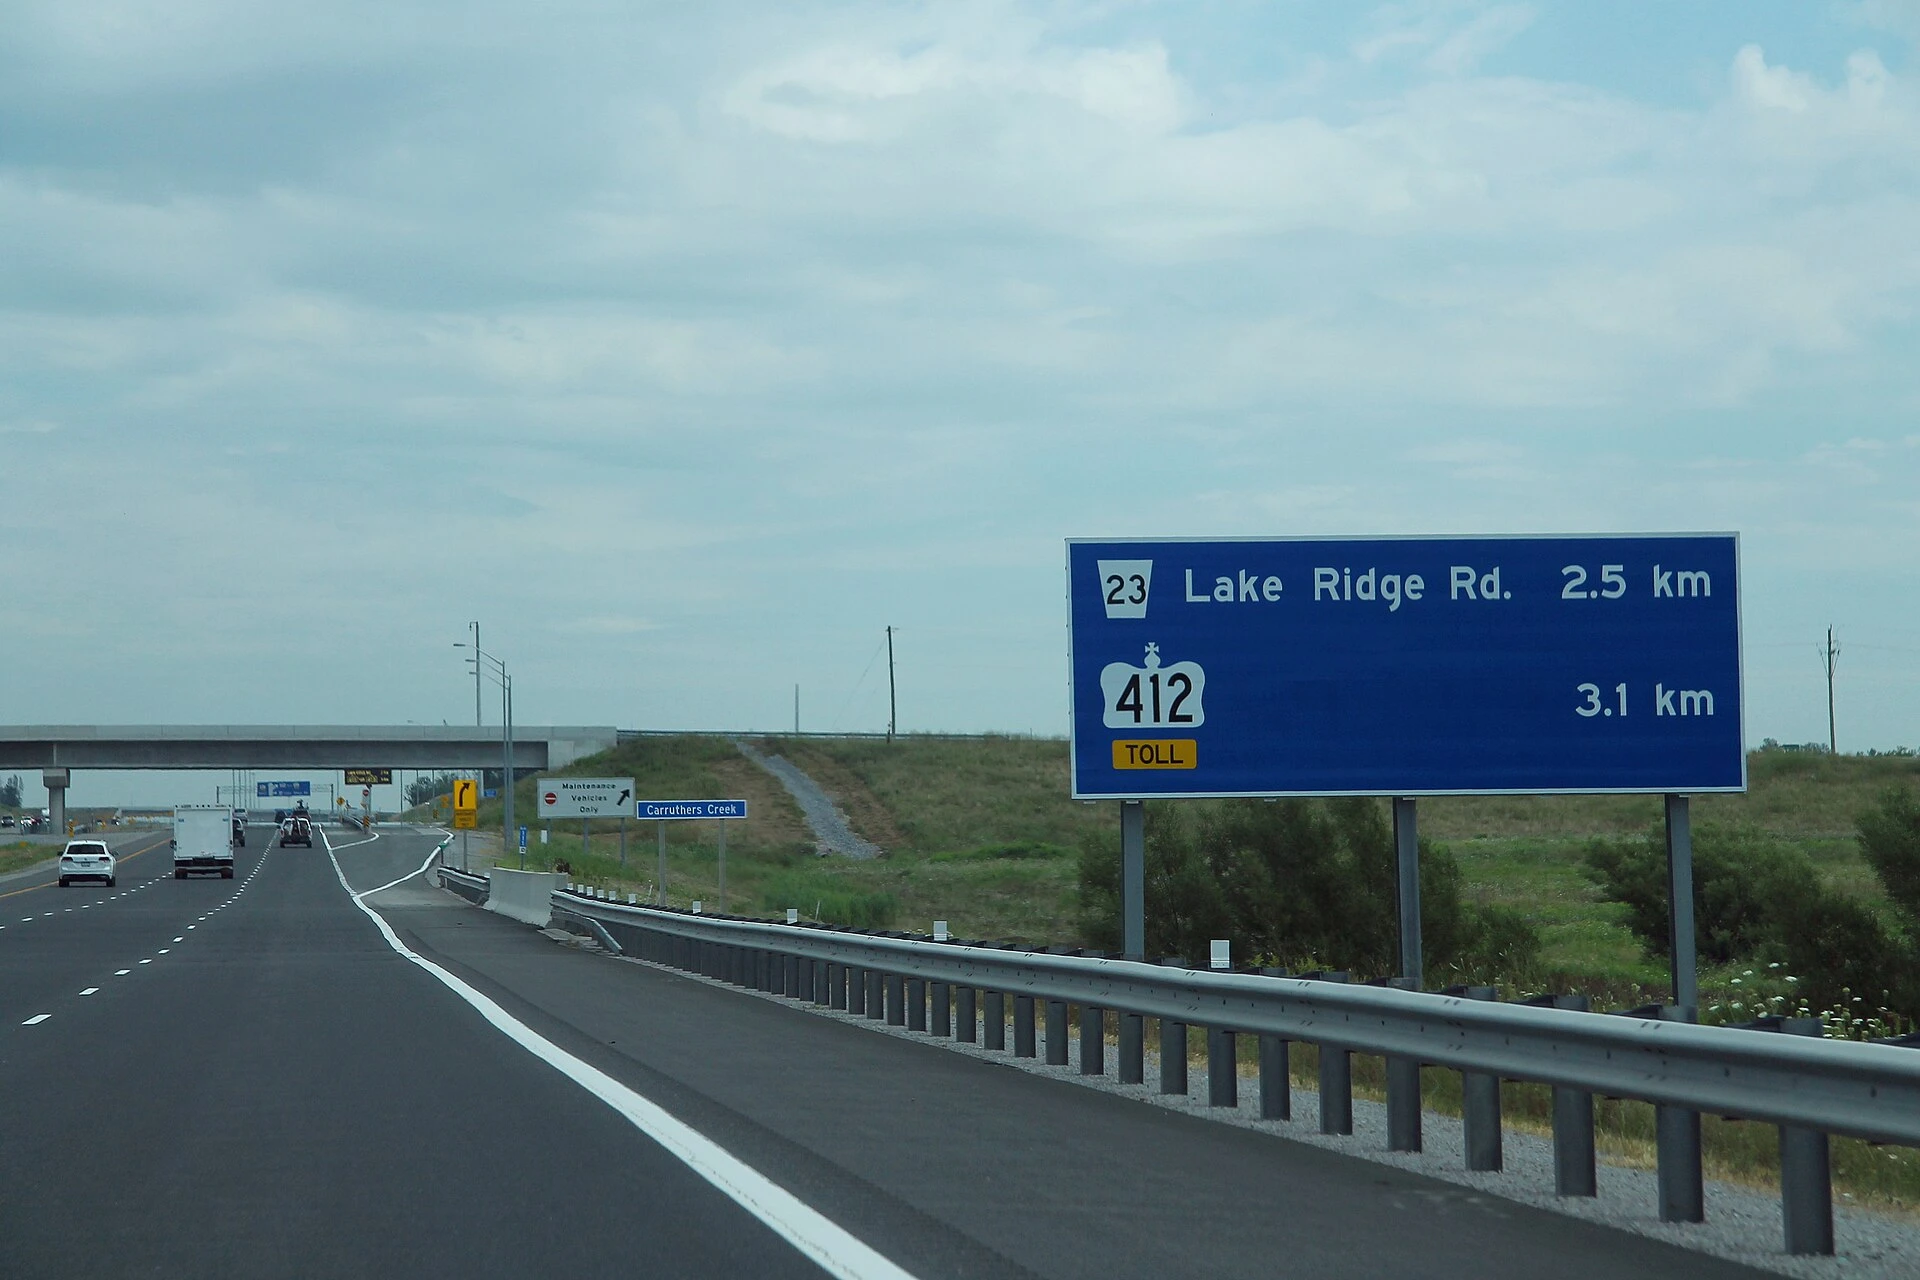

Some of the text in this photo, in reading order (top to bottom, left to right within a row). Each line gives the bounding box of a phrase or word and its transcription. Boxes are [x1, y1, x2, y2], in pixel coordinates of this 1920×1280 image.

[1106, 574, 1146, 605] 23
[1185, 564, 1711, 612] Lake Ridge Rd. 2.5 km
[1116, 672, 1193, 723] 412
[1575, 683, 1714, 717] 3.1 km
[1125, 744, 1184, 764] TOLL
[579, 806, 599, 814] Only
[647, 804, 737, 815] Carruthers Creek
